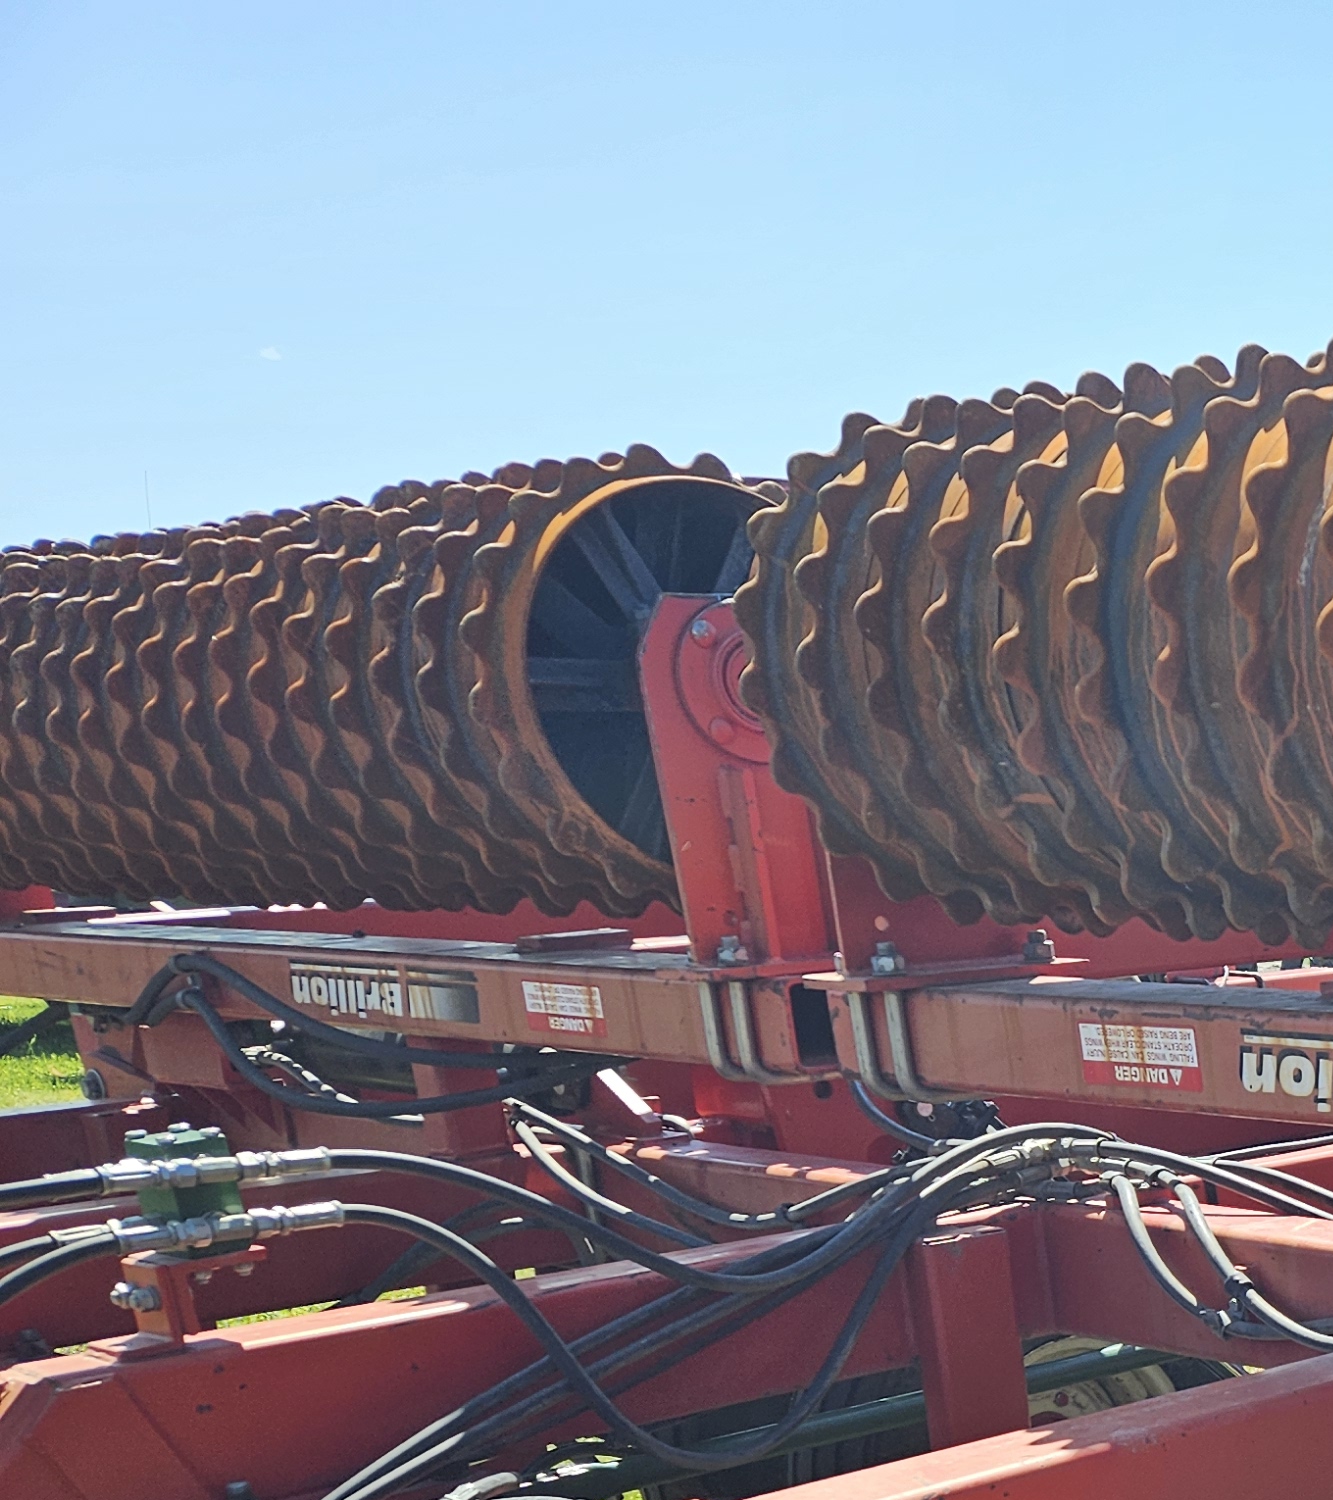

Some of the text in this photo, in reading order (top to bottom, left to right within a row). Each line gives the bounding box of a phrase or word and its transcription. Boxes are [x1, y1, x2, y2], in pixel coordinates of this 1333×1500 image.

[291, 975, 404, 1019] Brillion
[547, 1015, 586, 1032] DANGER
[1160, 1029, 1178, 1039] BEING
[1180, 1030, 1191, 1040] ARE
[1086, 1048, 1108, 1058] NJURY
[1147, 1051, 1167, 1061] WINGS
[1170, 1053, 1195, 1064] FALLING
[1114, 1065, 1169, 1084] DANGER
